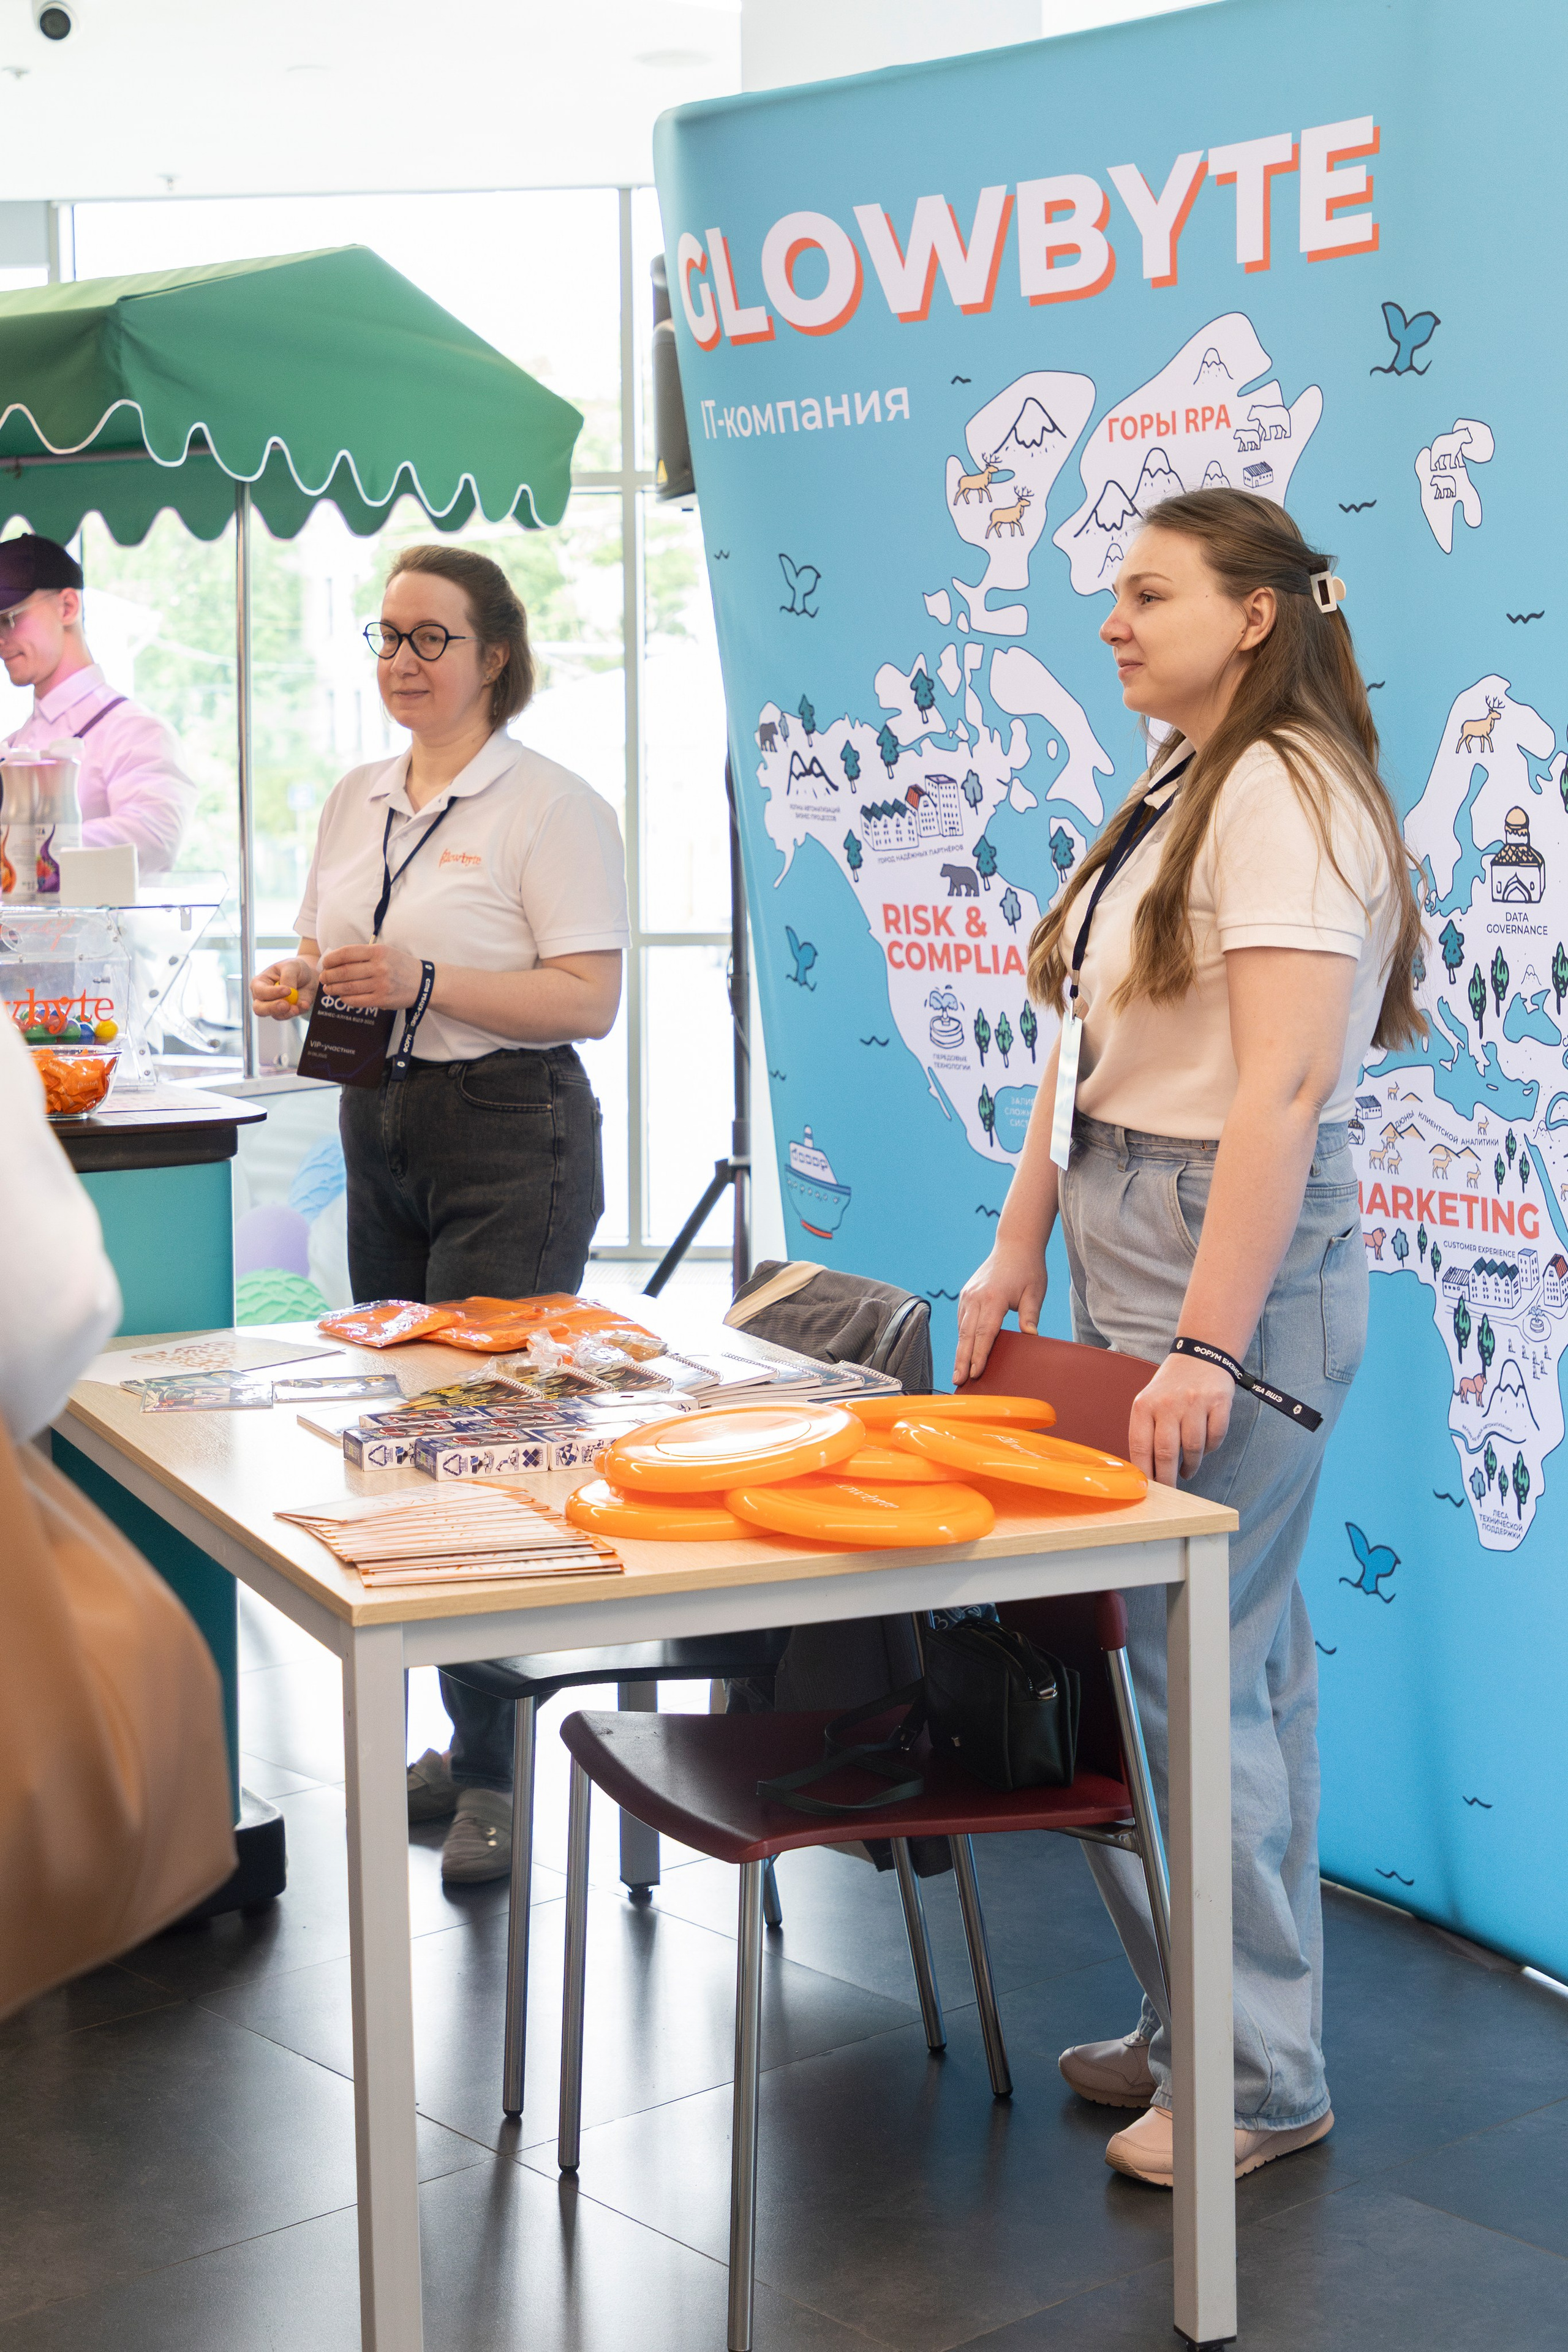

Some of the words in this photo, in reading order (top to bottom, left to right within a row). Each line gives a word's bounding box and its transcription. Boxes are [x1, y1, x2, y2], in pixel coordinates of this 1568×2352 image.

[677, 115, 1381, 352] GLOWBYTE
[700, 386, 910, 439] IT-компания
[1108, 410, 1177, 443] ГОРЫ
[1185, 404, 1232, 434] RPA
[882, 903, 956, 937] RISK
[965, 905, 988, 938] &
[1487, 924, 1548, 935] GOVERNANCE
[1506, 912, 1529, 922] DATA
[888, 940, 1028, 976] COMPLIA
[1395, 1109, 1415, 1129] ДЮНЫ
[1418, 1111, 1459, 1145] КЛИЕНТСКОЙ
[1443, 1240, 1477, 1252] CUSTOMER
[1478, 1246, 1516, 1259] EXPERIENCE
[1194, 1346, 1221, 1362] ФОРУМ
[1265, 1389, 1283, 1403] ВШЭ
[1479, 1513, 1523, 1532] ТЕХНИЧЕСКОЙ
[1482, 1523, 1521, 1540] ПОДДЕРЖКИ
[1493, 1509, 1509, 1520] ЛЕСА
